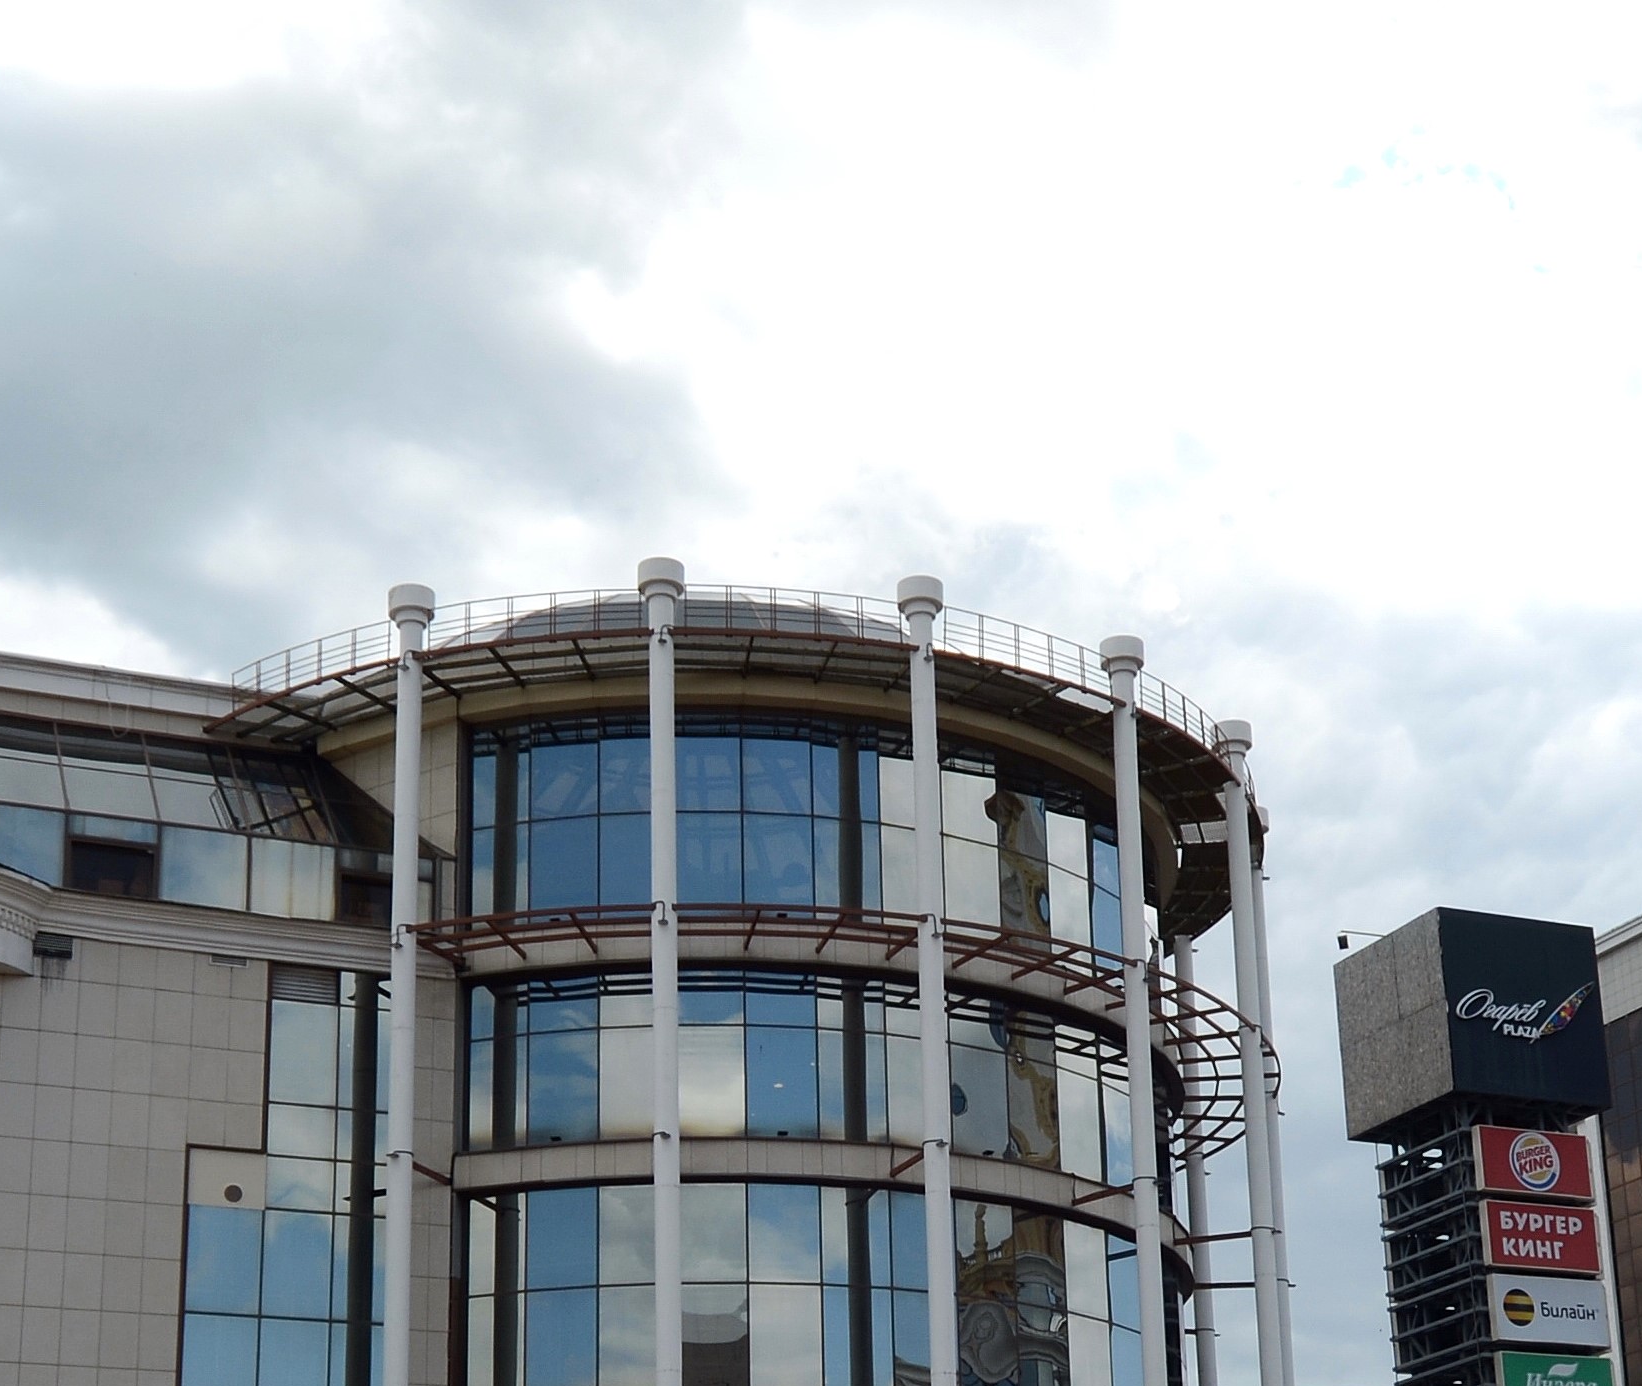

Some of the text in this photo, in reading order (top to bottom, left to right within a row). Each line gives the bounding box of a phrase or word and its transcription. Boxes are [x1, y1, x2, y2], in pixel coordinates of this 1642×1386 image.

[1503, 1023, 1542, 1039] PLAZA
[1516, 1144, 1551, 1160] BURGER
[1517, 1155, 1554, 1177] KING
[1499, 1210, 1583, 1235] БУРГЕР
[1502, 1237, 1564, 1260] КИНГ
[1540, 1301, 1596, 1320] Билайн
